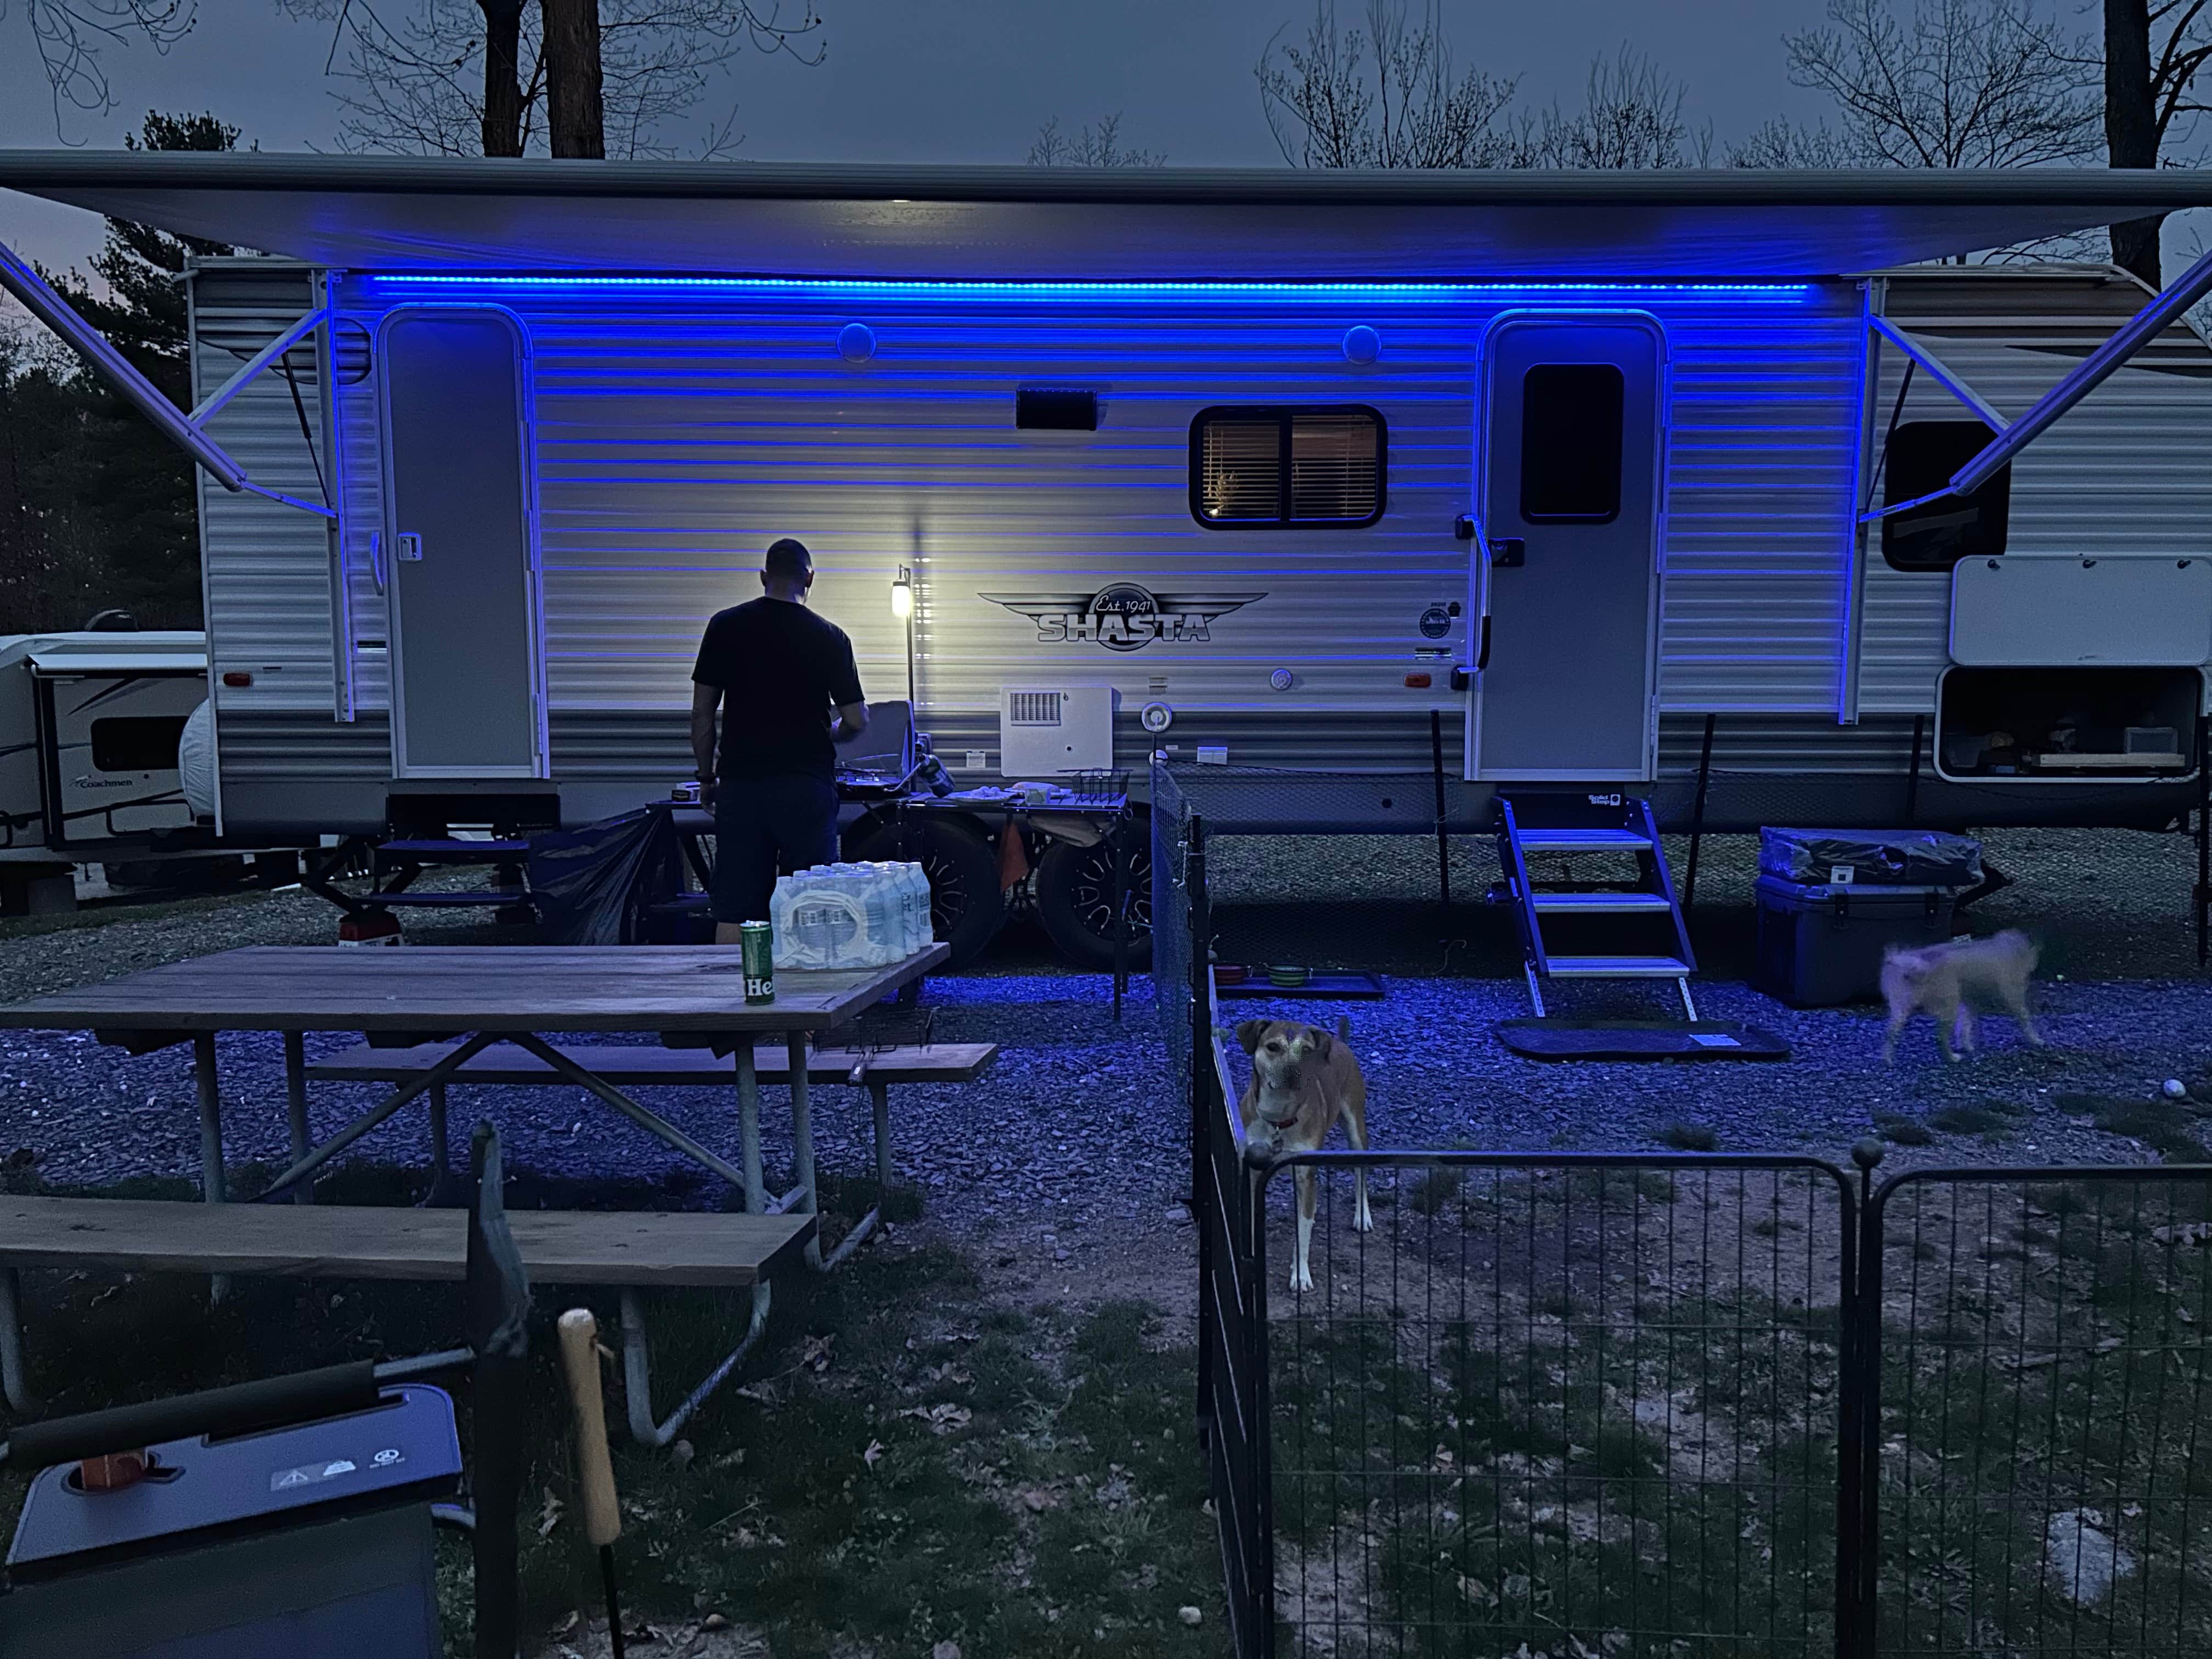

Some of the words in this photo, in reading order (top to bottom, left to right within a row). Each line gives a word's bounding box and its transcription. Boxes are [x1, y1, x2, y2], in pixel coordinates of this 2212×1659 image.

[1096, 595, 1124, 611] Est.
[1126, 601, 1151, 613] 1941
[1038, 613, 1210, 642] SHASTA
[80, 780, 132, 788] Coachmen
[746, 978, 775, 996] He
